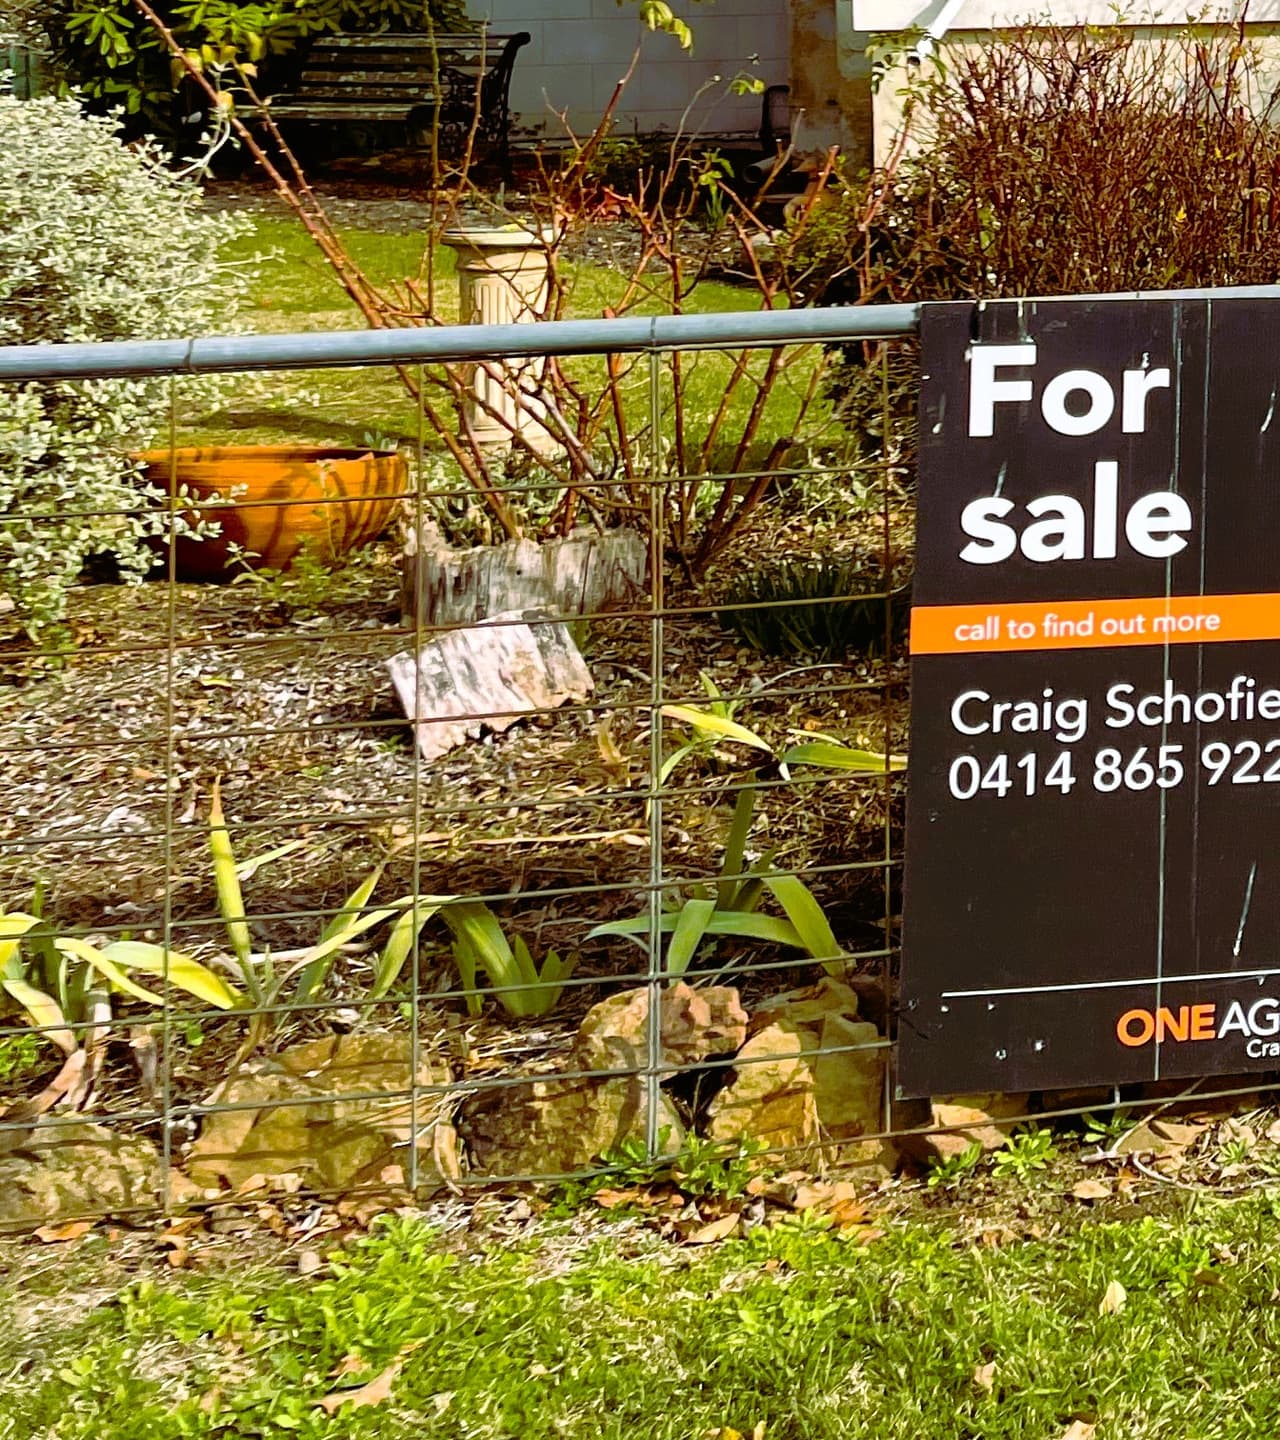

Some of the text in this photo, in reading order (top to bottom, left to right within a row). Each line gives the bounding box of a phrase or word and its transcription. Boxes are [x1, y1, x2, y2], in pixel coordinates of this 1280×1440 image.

[968, 343, 1170, 437] For
[958, 461, 1192, 564] sale
[954, 610, 1221, 642] call to find out more
[950, 688, 1088, 742] Craig
[948, 750, 1076, 799] 0414
[1092, 744, 1185, 792] 865
